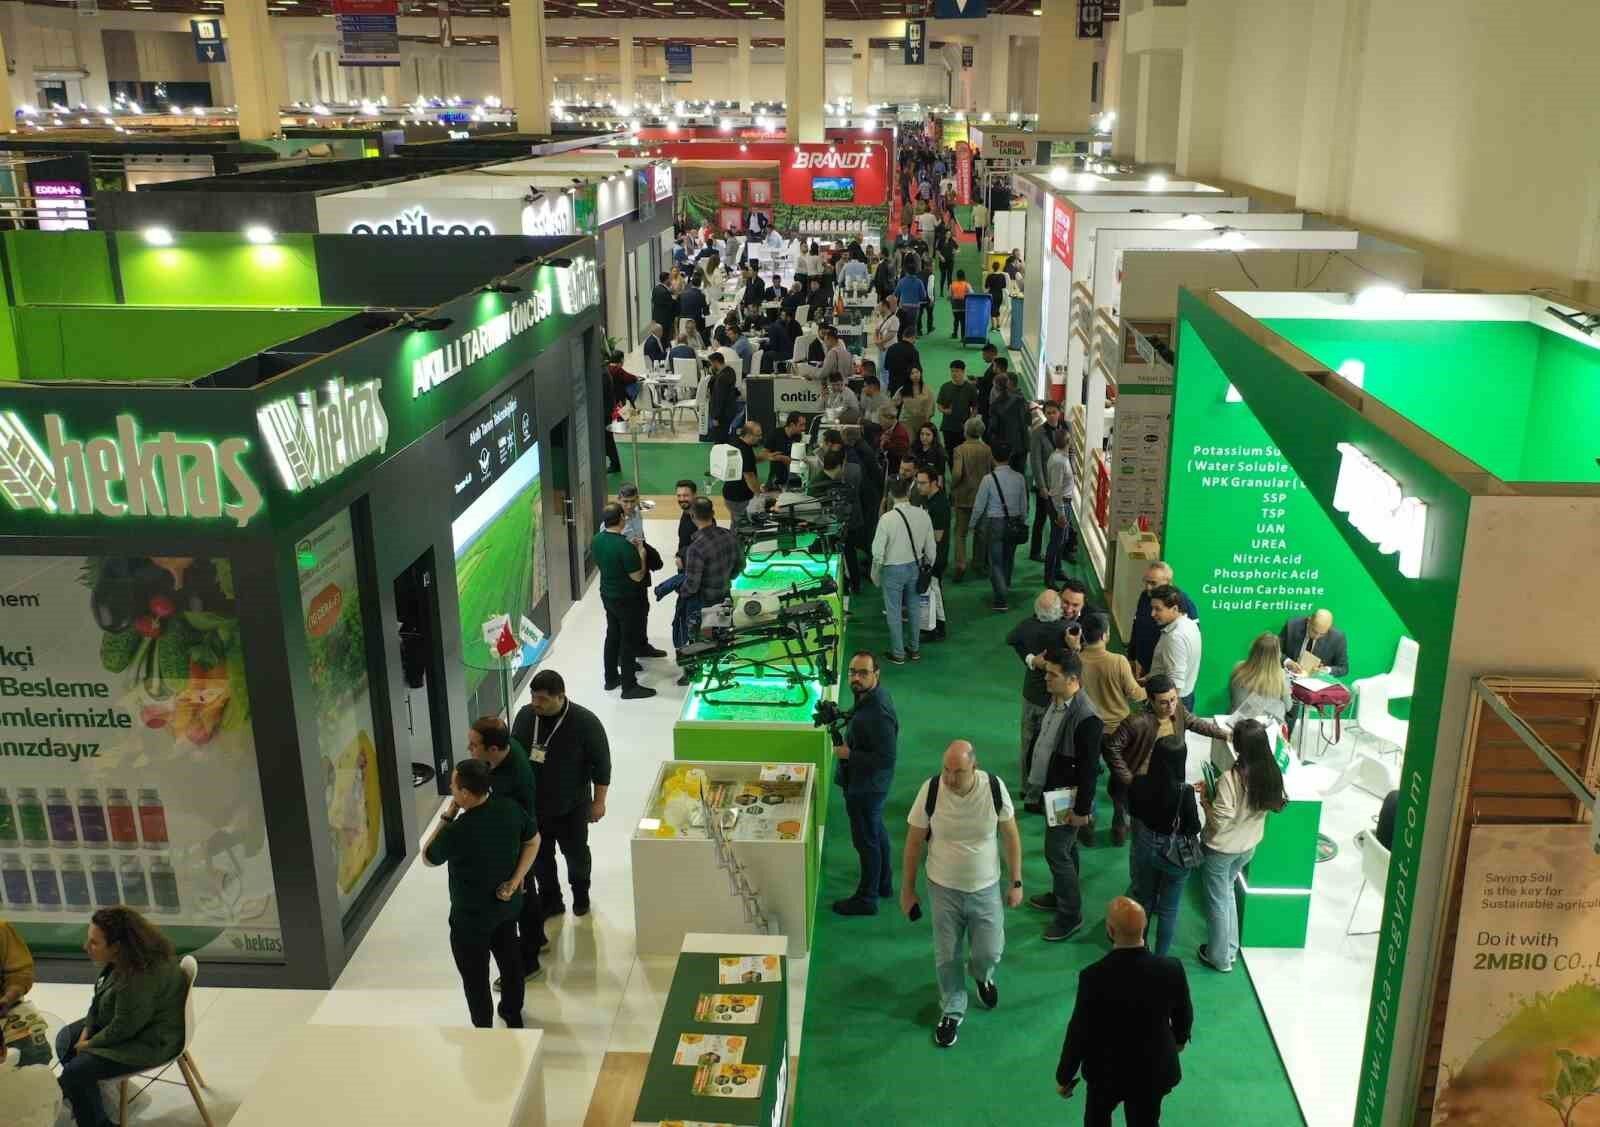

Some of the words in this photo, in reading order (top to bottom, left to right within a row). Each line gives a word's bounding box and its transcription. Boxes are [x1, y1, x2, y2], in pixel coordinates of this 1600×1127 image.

[1193, 446, 1262, 456] Potassium
[43, 413, 264, 528] hektaş
[1195, 461, 1235, 471] Water
[1238, 462, 1288, 472] Soluble
[1202, 477, 1229, 487] NPK
[1231, 477, 1291, 488] Granular
[1263, 492, 1287, 503] SSP
[1261, 508, 1286, 518] TSP
[1256, 523, 1285, 534] UAN
[1251, 539, 1287, 549] UREA
[1233, 553, 1270, 564] Nitric
[1272, 554, 1302, 565] Acid
[1214, 568, 1288, 580] Phosphoric
[1291, 569, 1319, 579] Acid
[1202, 584, 1254, 594] Calcium
[1256, 585, 1324, 595] Carbonate
[1212, 600, 1251, 611] Liquid
[1254, 600, 1313, 610] Fertilizer
[1, 677, 109, 698] Besleme
[0, 707, 132, 728] mlerimizle
[1485, 872, 1528, 884] Saving
[1530, 872, 1552, 882] Soil
[1483, 887, 1494, 897] is
[1497, 886, 1517, 897] the
[1520, 886, 1543, 898] key
[1545, 886, 1565, 897] for
[1481, 898, 1553, 910] Sustainable
[1477, 931, 1501, 946] Do
[1504, 931, 1517, 946] it
[1520, 931, 1559, 947] with
[1473, 952, 1548, 970] 2MBIO
